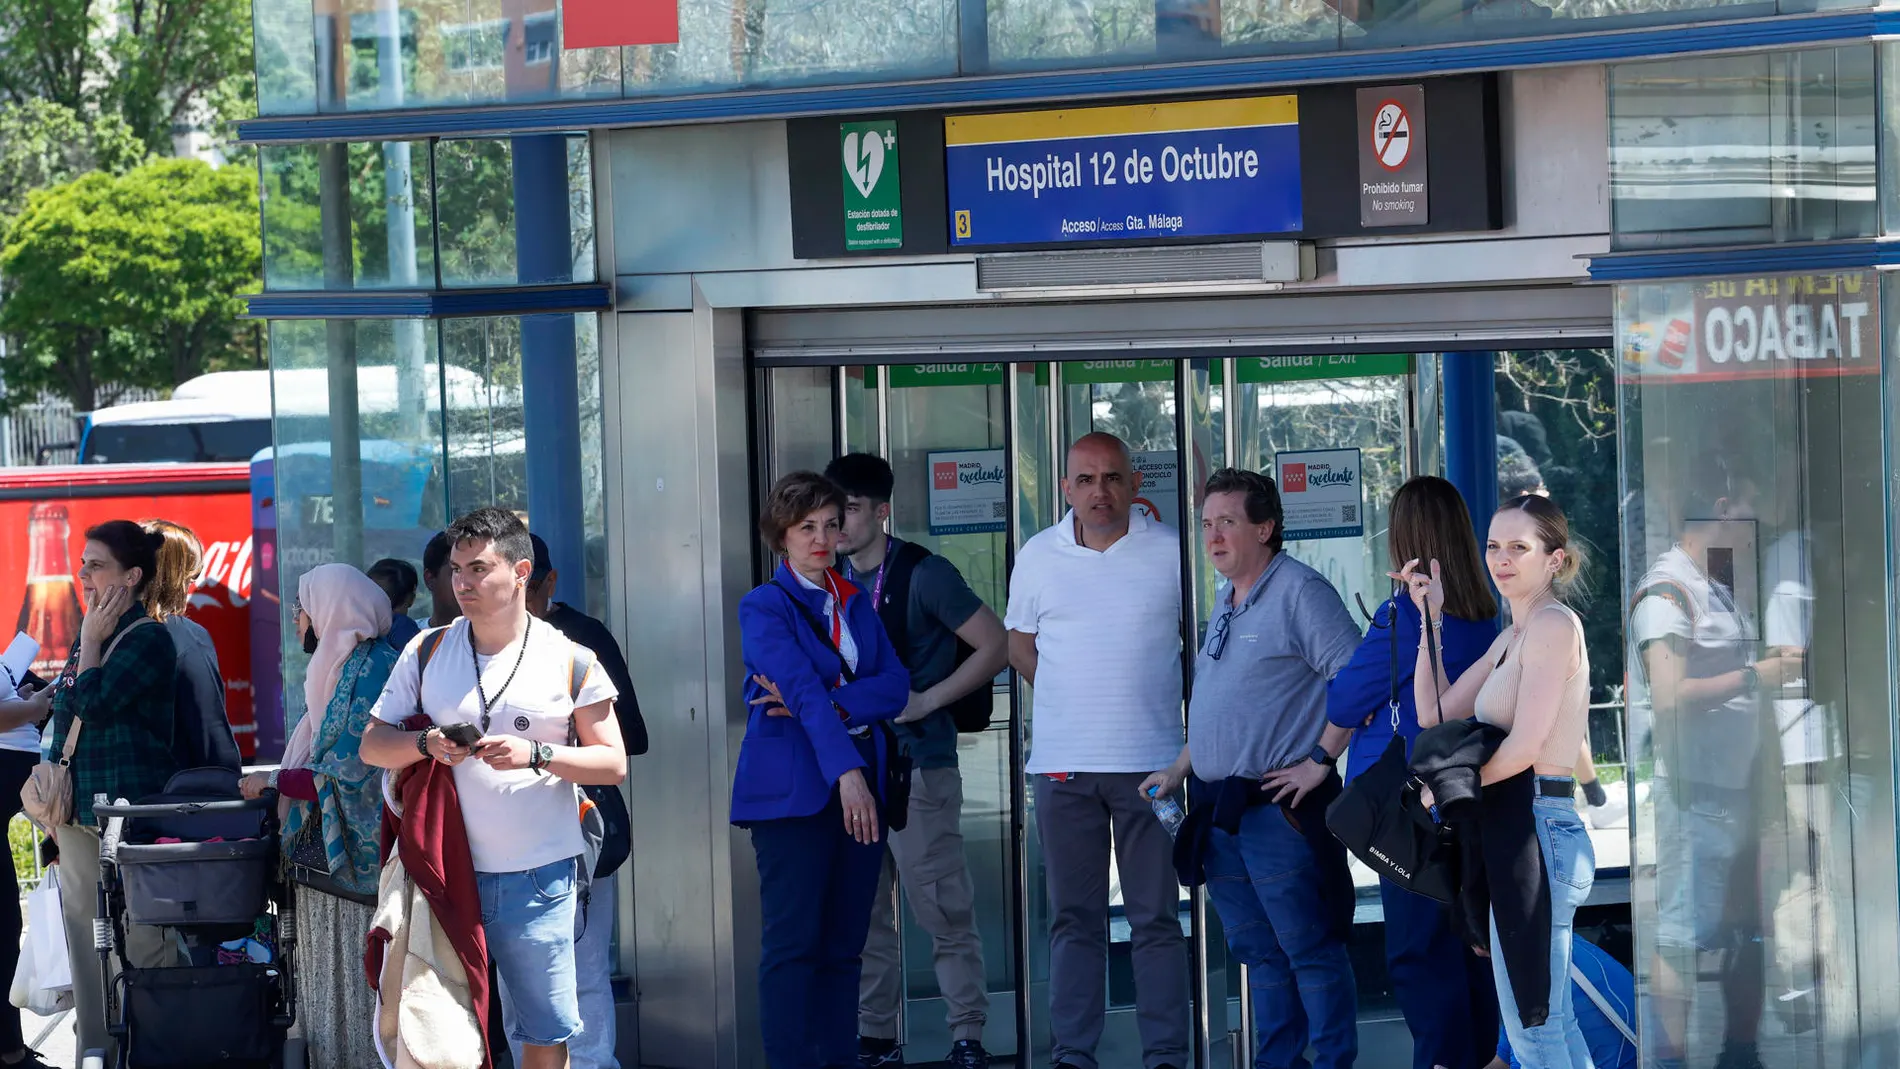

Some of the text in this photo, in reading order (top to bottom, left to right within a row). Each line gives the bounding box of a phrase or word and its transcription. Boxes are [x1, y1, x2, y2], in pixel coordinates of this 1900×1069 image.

[987, 143, 1259, 198] Hospital 12 de Octubre
[1363, 182, 1424, 194] Prohibido fumar
[847, 208, 898, 218] Estación dotada de
[1372, 199, 1415, 213] No smoking
[856, 222, 890, 231] desfibrilador
[958, 213, 968, 234] 3
[1126, 215, 1146, 230] Gta.
[1148, 213, 1183, 231] Málaga
[983, 363, 1003, 371] Ex
[1150, 359, 1172, 367] Exi
[959, 466, 1005, 484] excelente
[1308, 467, 1355, 486] excelente
[1369, 846, 1389, 863] BIMBA
[1394, 865, 1410, 879] LOLA
